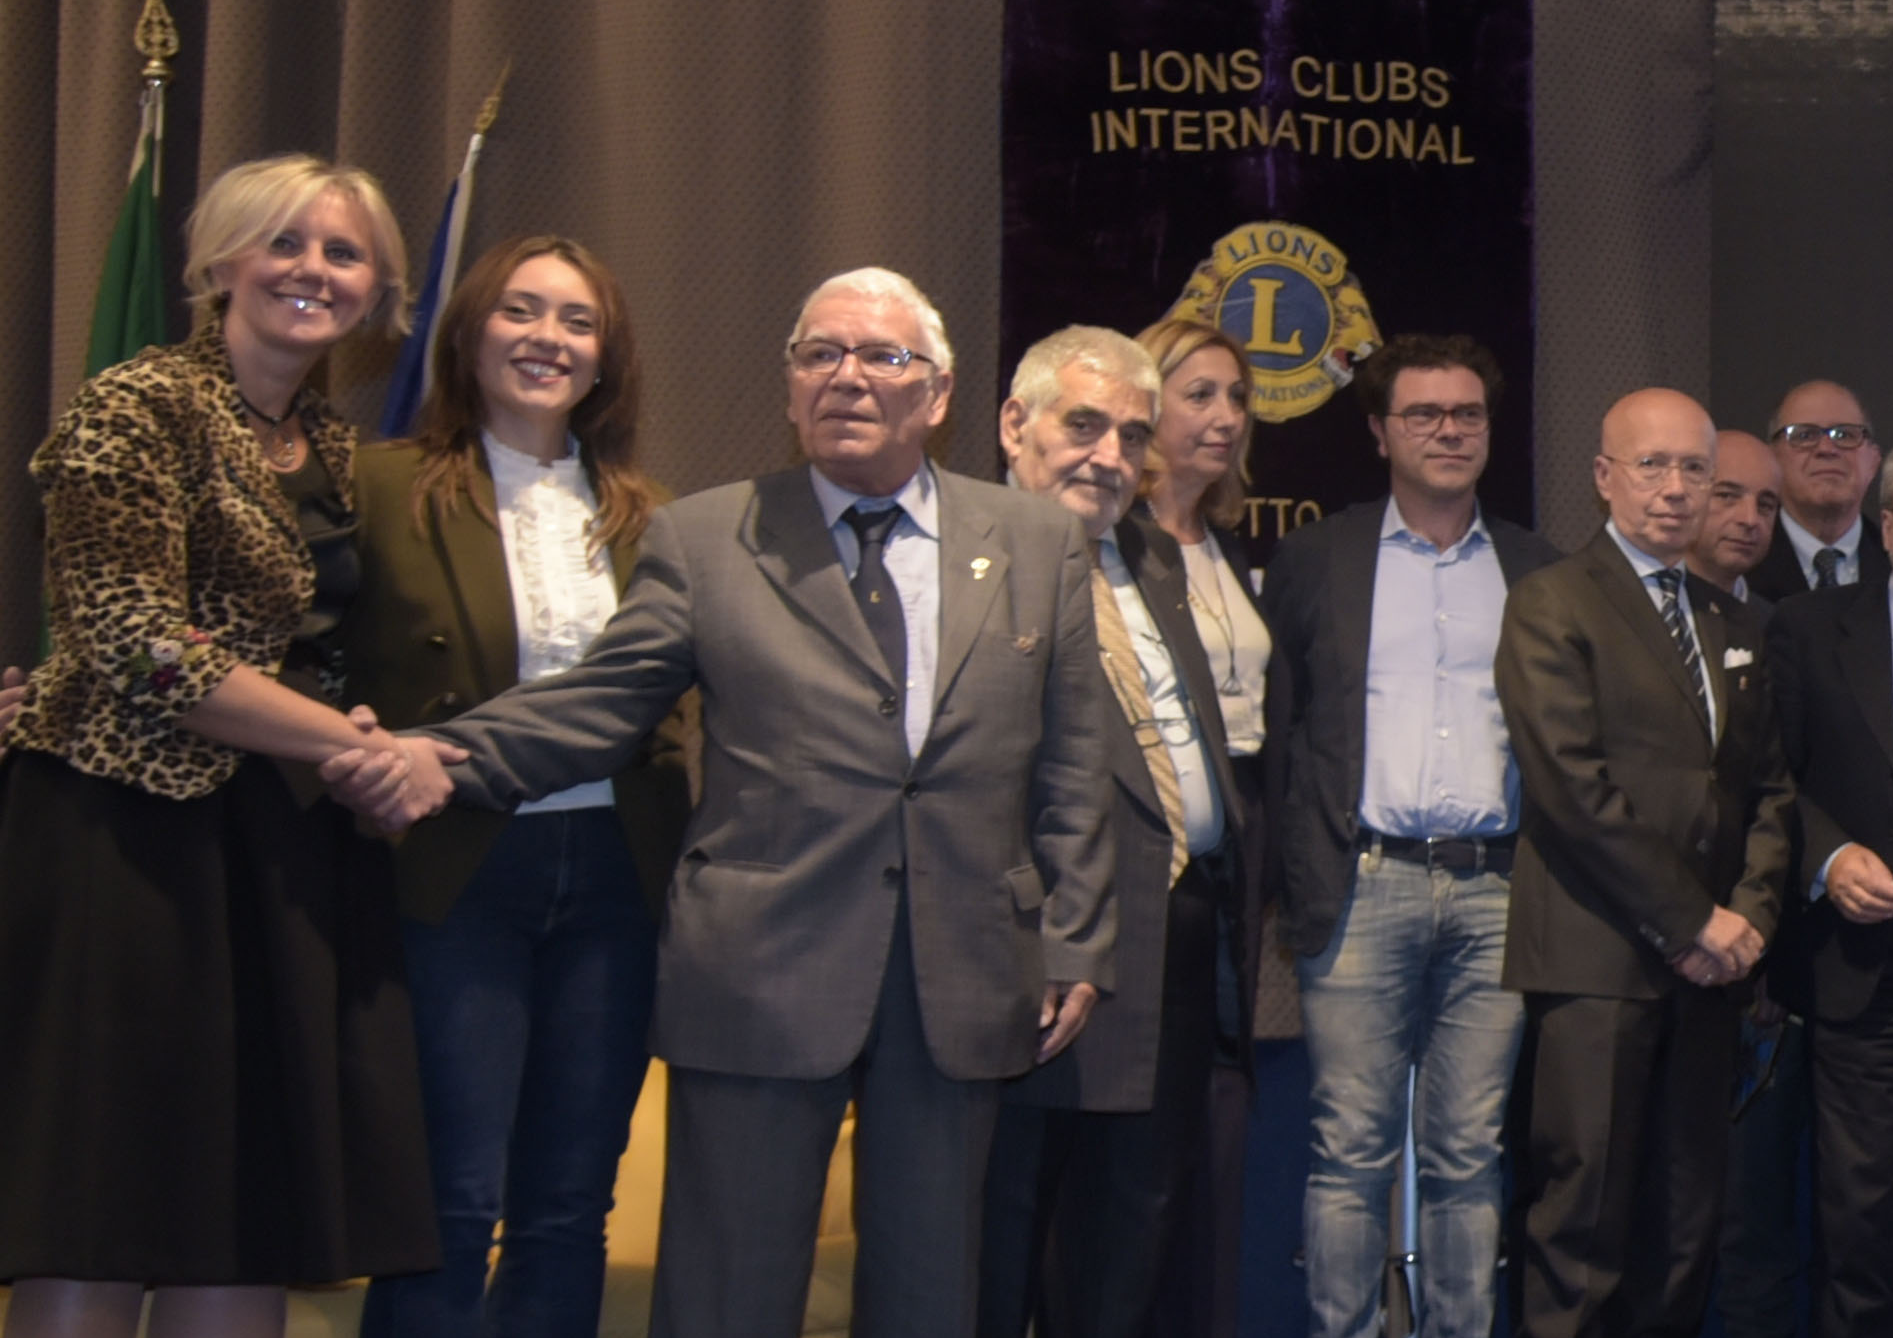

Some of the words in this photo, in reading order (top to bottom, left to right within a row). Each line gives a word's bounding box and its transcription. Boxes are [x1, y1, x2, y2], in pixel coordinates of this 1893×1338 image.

[1109, 49, 1264, 94] LIONS
[1291, 56, 1451, 109] CLUBS
[1090, 105, 1475, 165] INTERNATIONAL
[1228, 229, 1337, 276] LIONS
[1244, 278, 1304, 356] L
